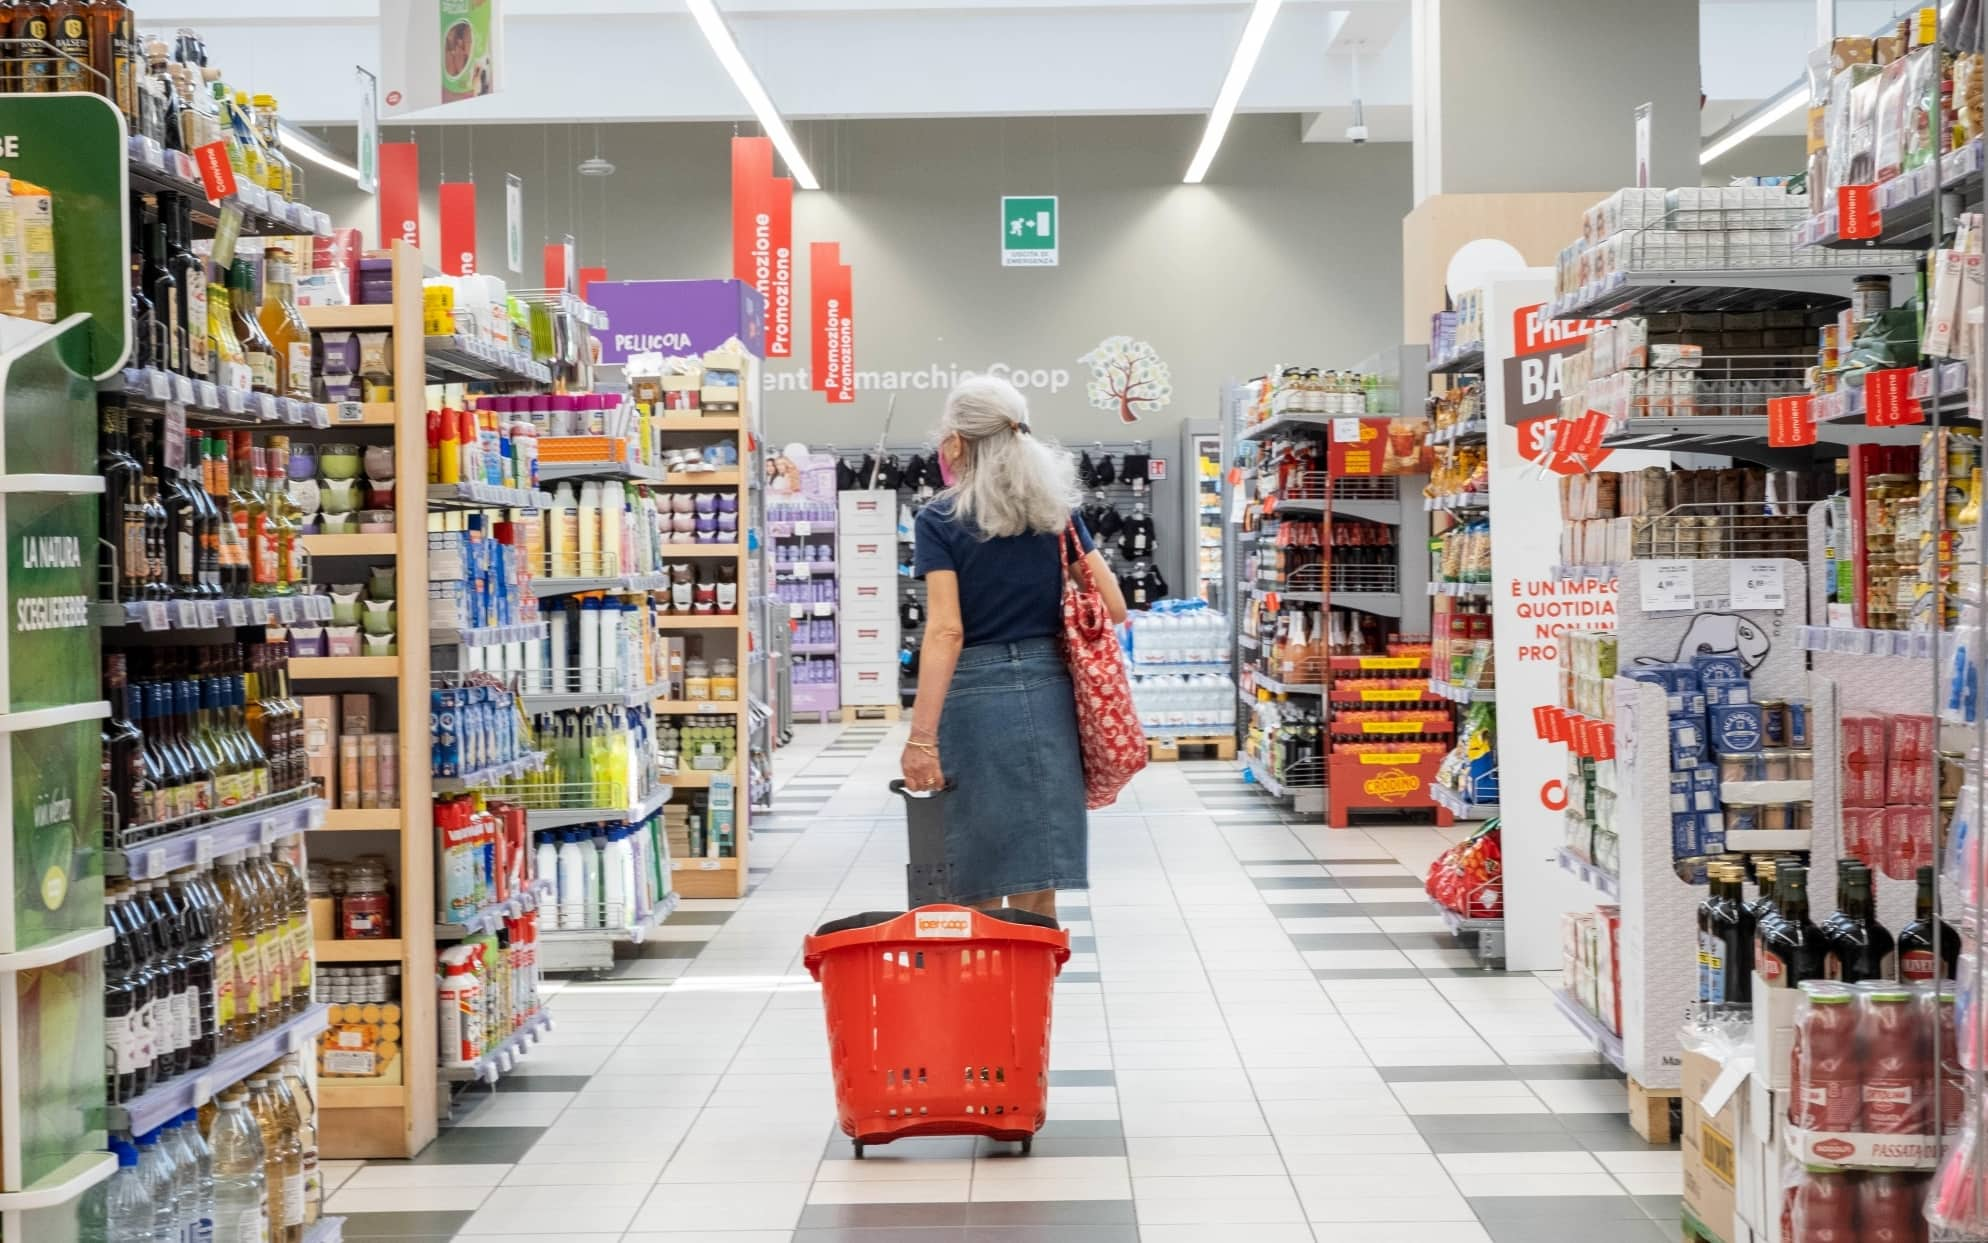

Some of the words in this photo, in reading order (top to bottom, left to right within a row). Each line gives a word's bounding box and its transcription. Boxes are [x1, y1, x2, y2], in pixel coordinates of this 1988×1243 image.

[206, 147, 227, 193] Conviene
[1847, 189, 1857, 234] Conviene
[772, 247, 790, 354] Promozione
[614, 332, 693, 352] PELLICOLA
[825, 298, 840, 389] Promozione
[839, 317, 852, 401] Promozione
[1889, 373, 1899, 421] Conviene
[1791, 400, 1802, 442] Conviene
[22, 535, 39, 568] LA
[39, 535, 81, 568] NATURA
[1511, 578, 1521, 597] È
[1528, 581, 1555, 597] UN
[1516, 600, 1615, 618] QUOTIDIA
